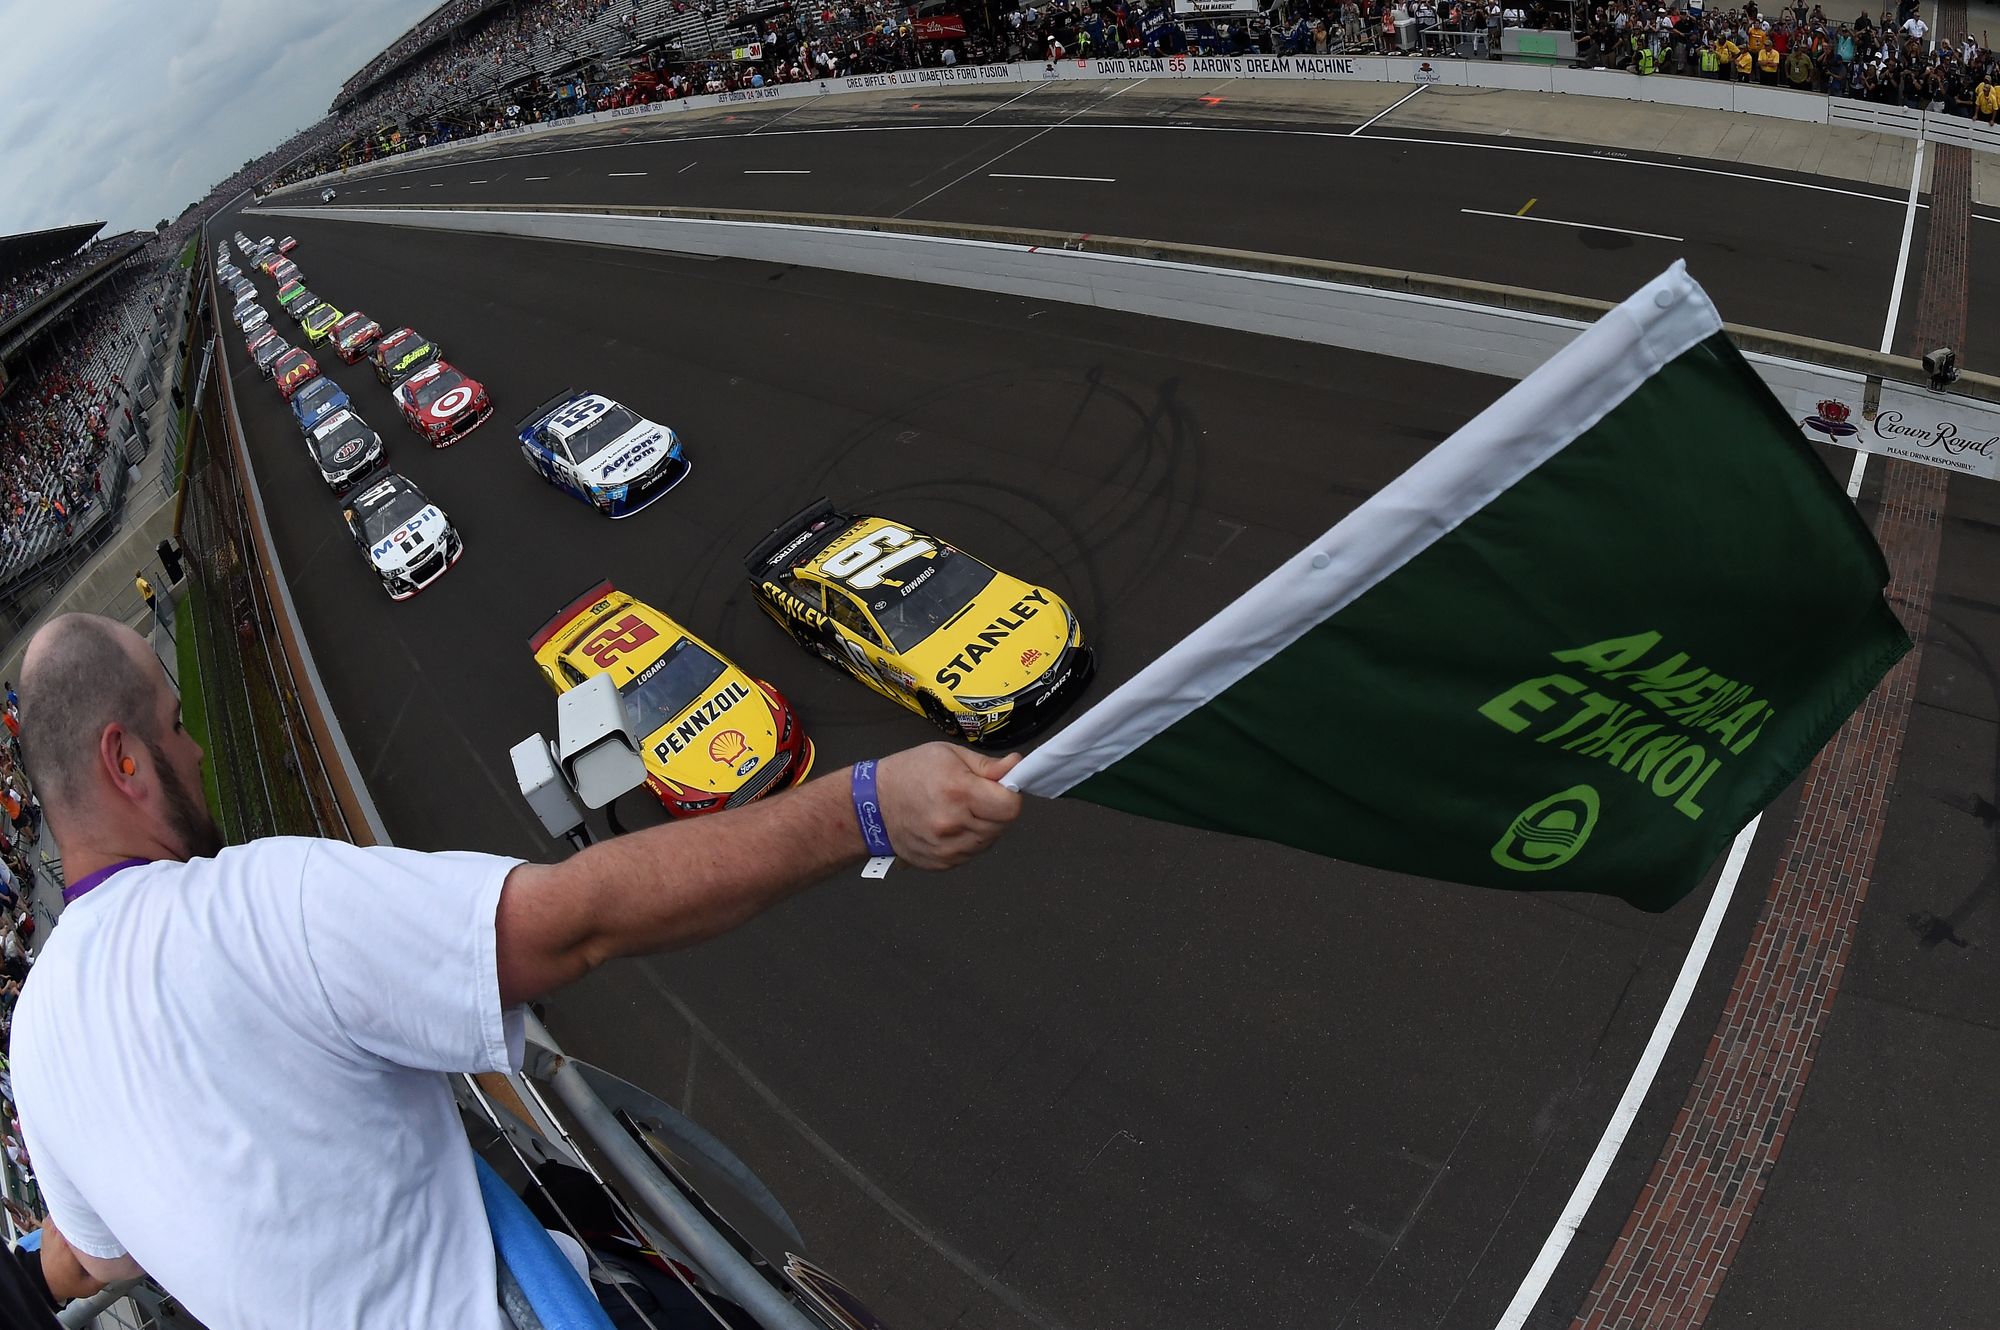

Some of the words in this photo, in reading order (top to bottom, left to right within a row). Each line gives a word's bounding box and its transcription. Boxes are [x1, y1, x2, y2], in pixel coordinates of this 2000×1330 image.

[750, 44, 760, 56] 3M
[865, 75, 886, 87] BIFFLE
[888, 74, 897, 85] 16
[899, 73, 916, 84] LILLY
[919, 69, 954, 82] DIABETES
[956, 68, 977, 80] FORD
[980, 66, 1009, 78] FUSION
[1097, 61, 1125, 74] DAVID
[1168, 59, 1187, 72] 55
[1192, 59, 1242, 72] AARON'S
[1247, 59, 1291, 73] DREAM
[1295, 59, 1354, 74] MACHINE
[575, 82, 587, 99] 51
[718, 94, 729, 103] JEFF
[765, 88, 780, 97] CHEVY
[553, 398, 605, 428] 55
[587, 417, 603, 430] RAGAN
[1874, 411, 1931, 439] Crown
[1916, 422, 1999, 456] Royal
[591, 459, 604, 472] Now
[602, 432, 662, 479] Aaron's
[623, 446, 657, 473] .com
[1887, 447, 1909, 456] PLEASE
[1909, 451, 1931, 461] DRINK
[552, 461, 575, 488] 55
[641, 469, 668, 490] CAMRY
[612, 491, 624, 500] 55
[372, 508, 437, 560] Mobil
[814, 522, 869, 564] STANLEY
[769, 532, 813, 566] SONITROL
[818, 525, 937, 590] 19
[900, 566, 936, 597] EDWARDS
[762, 581, 829, 632] STANLEY
[582, 614, 660, 668] 22
[935, 588, 1051, 691] STANLEY
[1020, 648, 1039, 666] MAC
[636, 658, 666, 686] LOGANO
[1036, 668, 1072, 706] CAMRY
[654, 681, 750, 765] PENNZOIL
[986, 712, 999, 723] 19
[1477, 674, 1722, 820] ETHANOL
[740, 759, 756, 775] Ford
[863, 801, 877, 824] Crown
[865, 819, 885, 847] Royal
